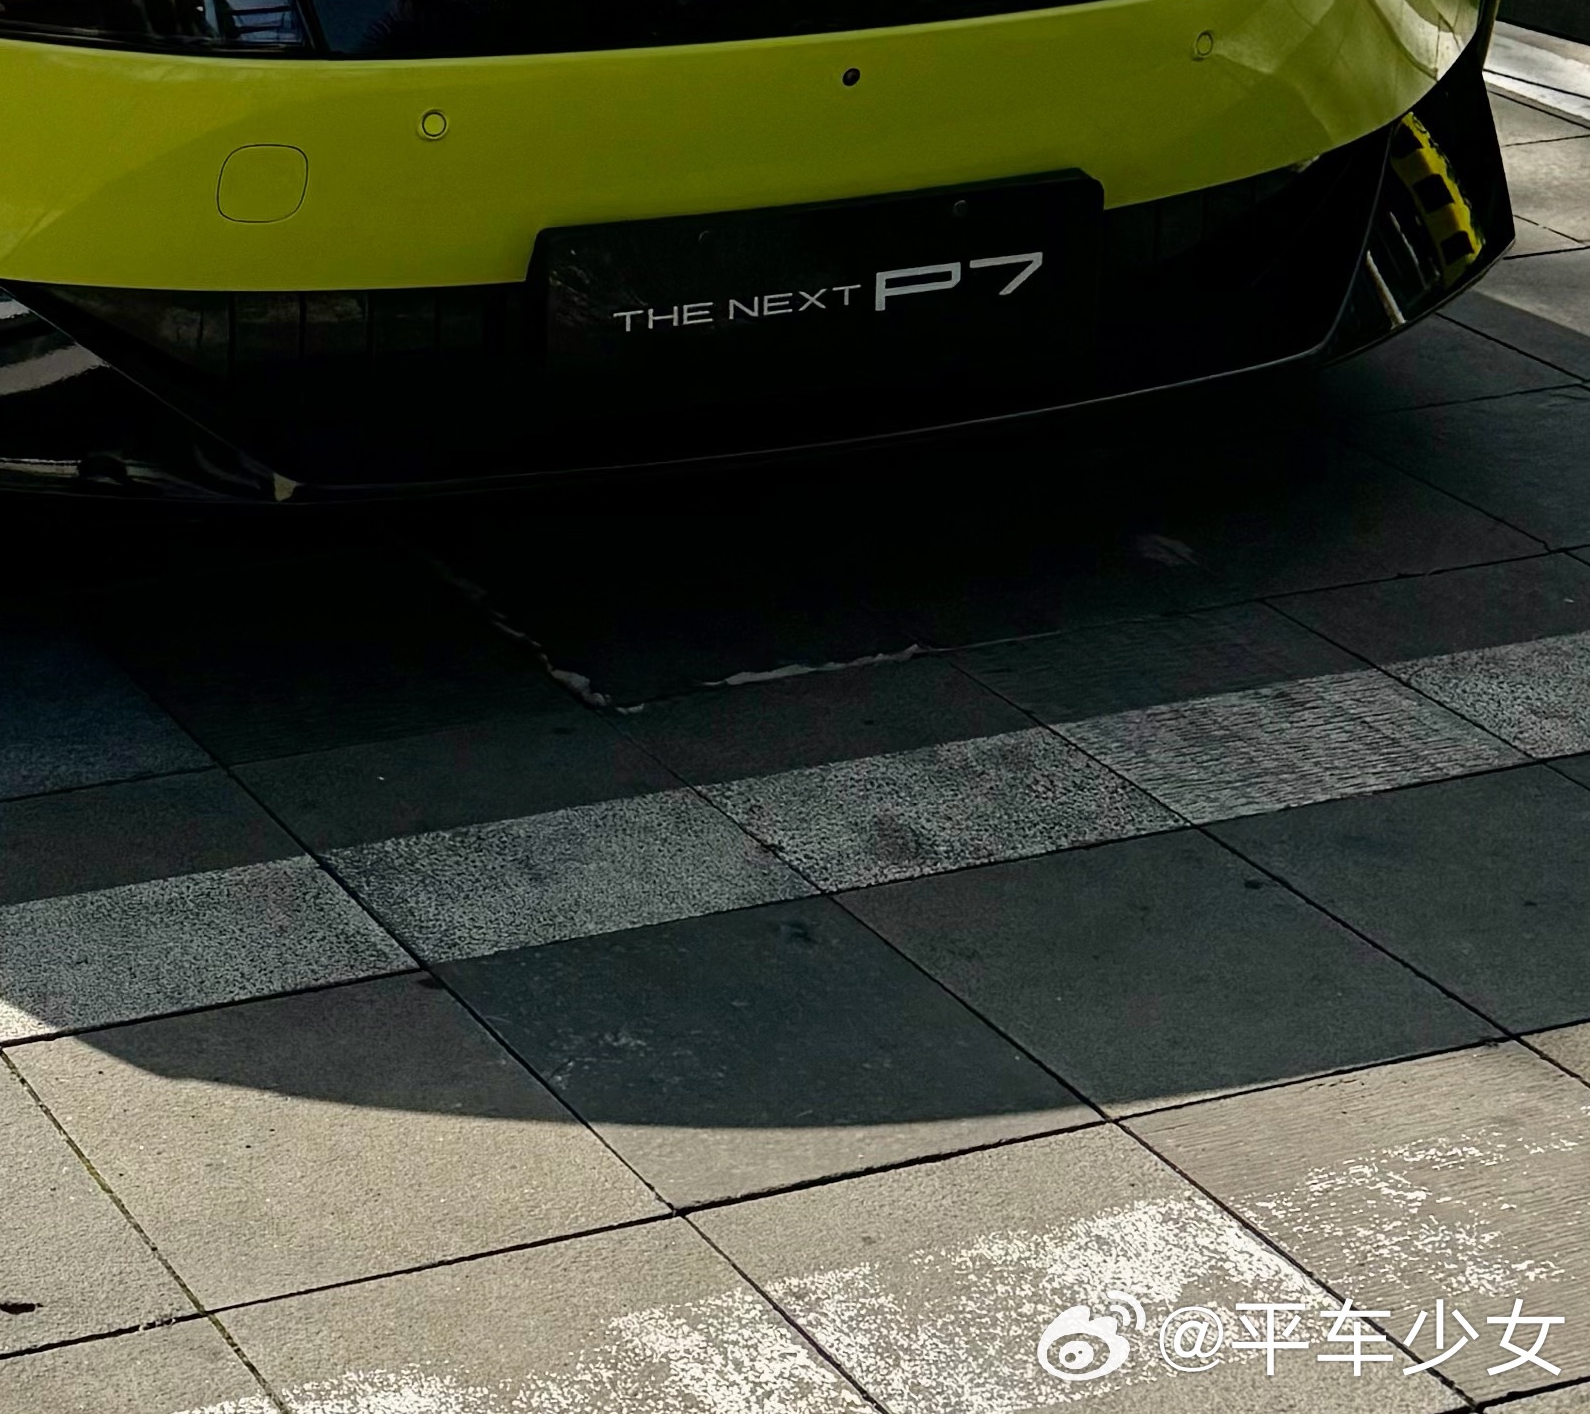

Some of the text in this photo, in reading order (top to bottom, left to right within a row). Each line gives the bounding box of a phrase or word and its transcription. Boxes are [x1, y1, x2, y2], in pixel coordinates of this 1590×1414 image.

[613, 251, 1043, 332] THE NEXT P7
